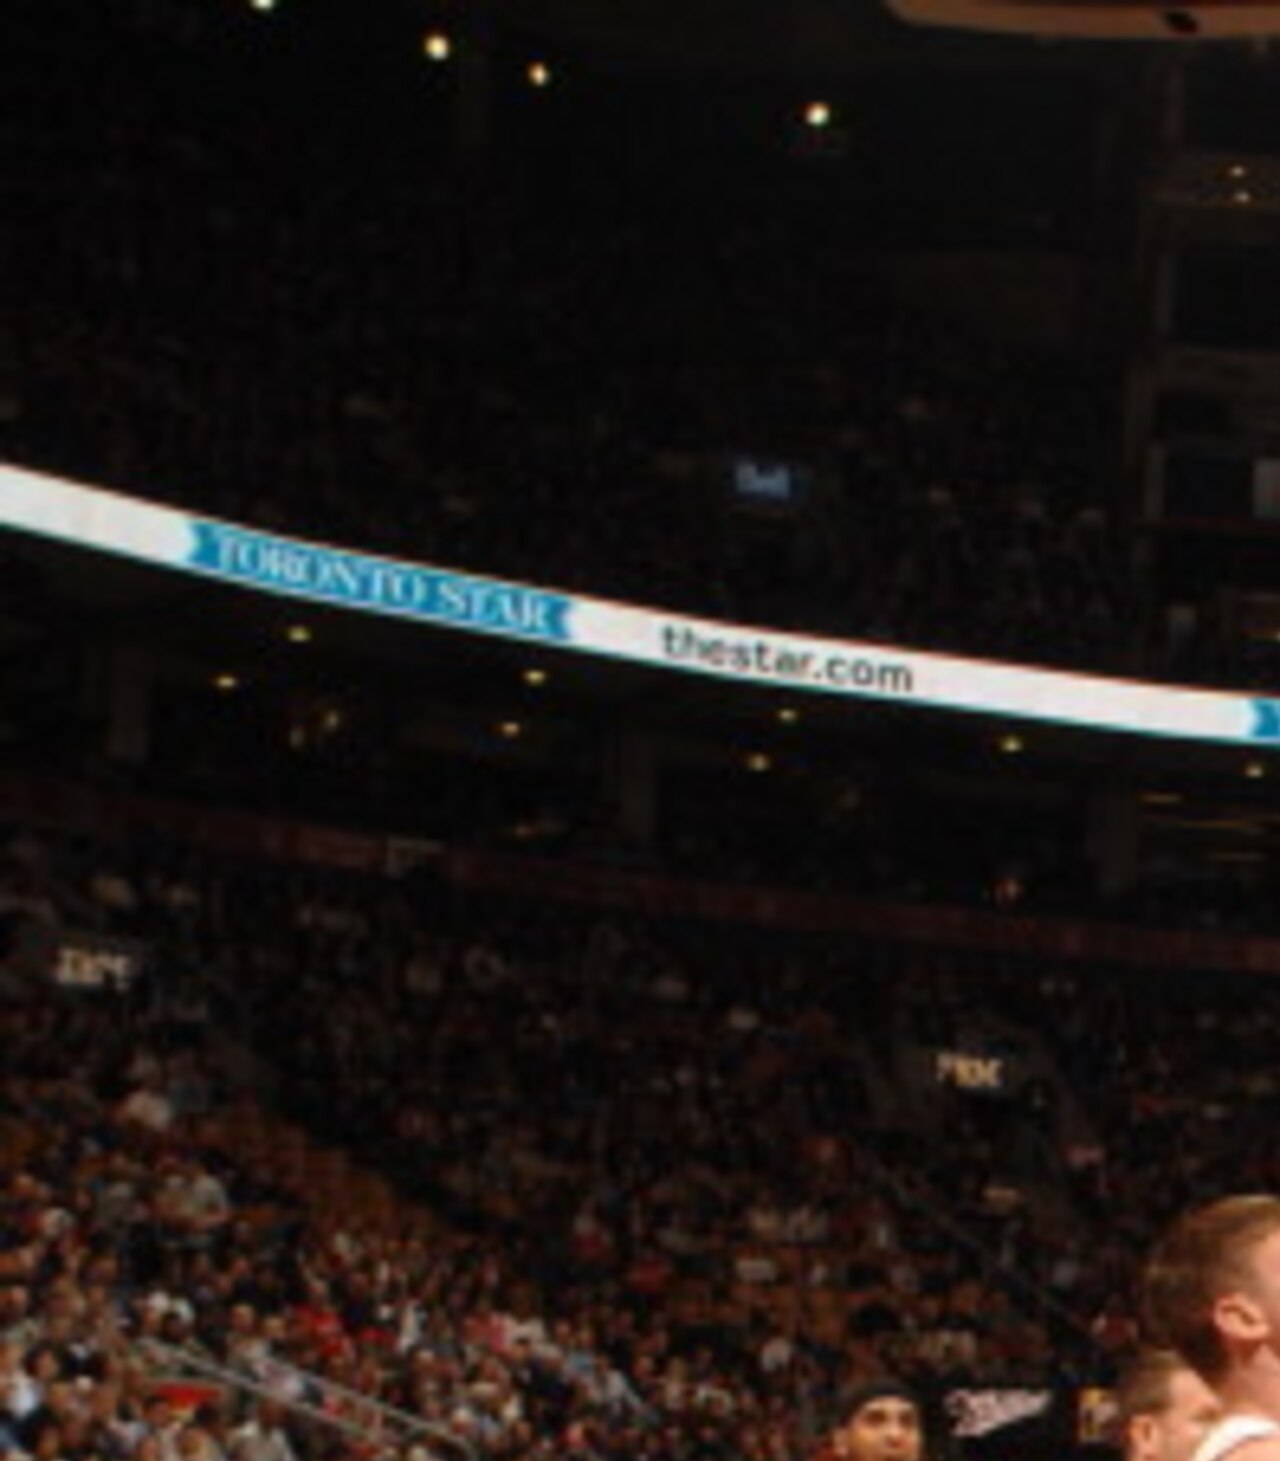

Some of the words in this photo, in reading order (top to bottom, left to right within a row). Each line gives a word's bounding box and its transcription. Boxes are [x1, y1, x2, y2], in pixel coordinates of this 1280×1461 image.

[218, 536, 427, 604] TORONTO
[437, 580, 552, 630] STAR
[662, 626, 914, 692] thestar.com
